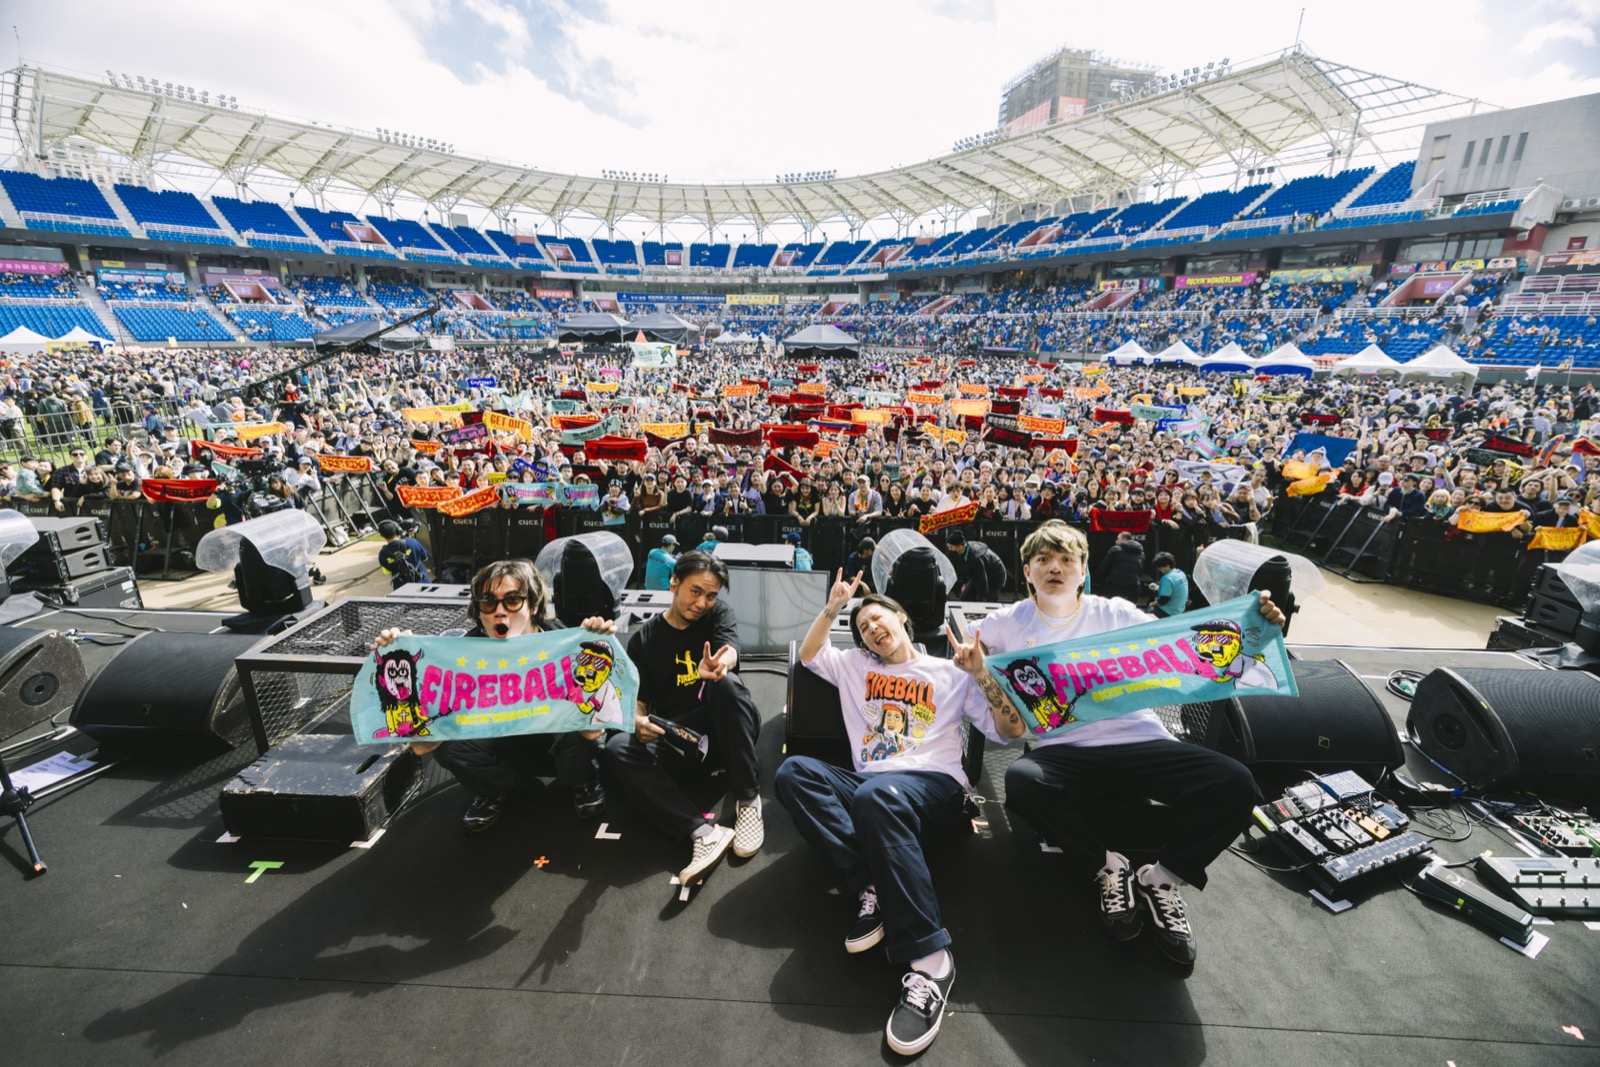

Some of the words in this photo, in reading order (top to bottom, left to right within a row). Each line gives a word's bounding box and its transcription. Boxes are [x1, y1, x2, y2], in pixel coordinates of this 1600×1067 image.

[490, 414, 507, 426] GET
[508, 419, 526, 431] OUT
[420, 655, 584, 718] FIREBALL
[865, 671, 937, 715] FIREBALL
[1047, 637, 1219, 706] FIREBALL
